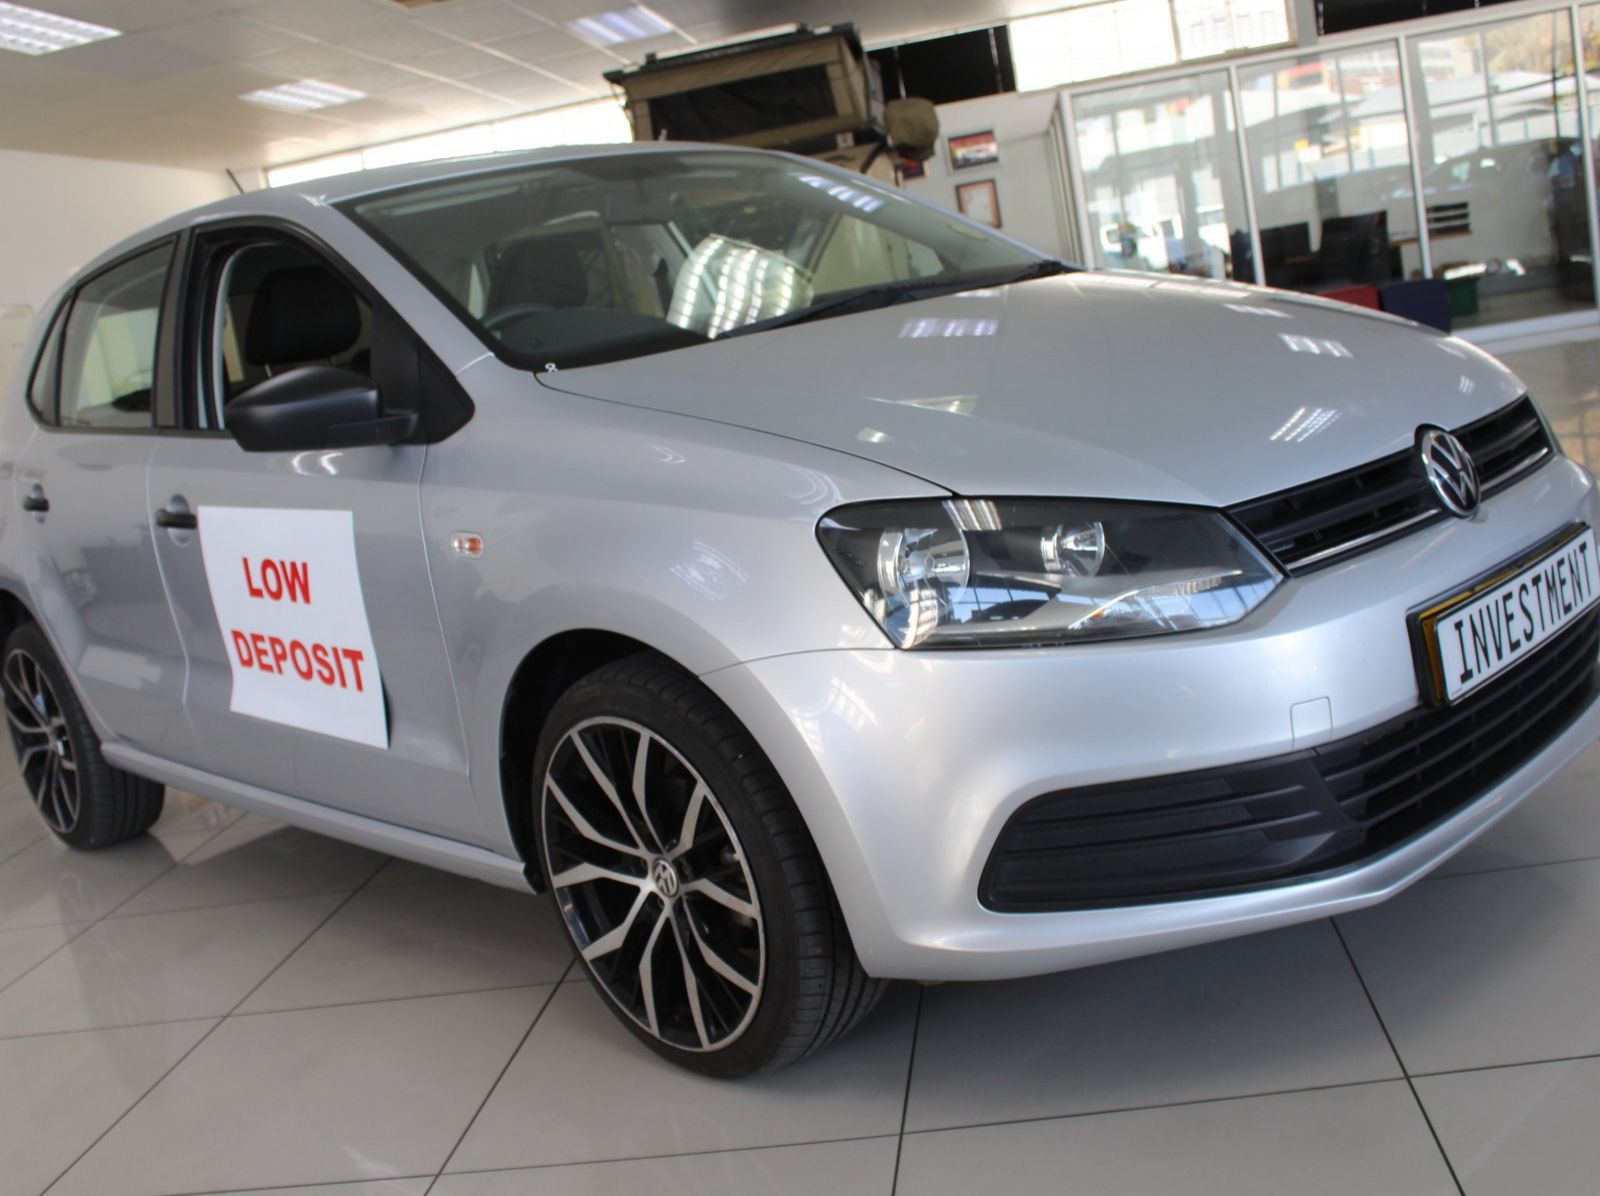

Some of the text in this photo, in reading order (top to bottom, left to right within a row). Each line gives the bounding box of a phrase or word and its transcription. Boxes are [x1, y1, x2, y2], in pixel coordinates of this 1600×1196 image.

[242, 556, 311, 605] LOW
[1453, 541, 1592, 684] INVESTMENT
[231, 629, 364, 692] DEPOSIT
